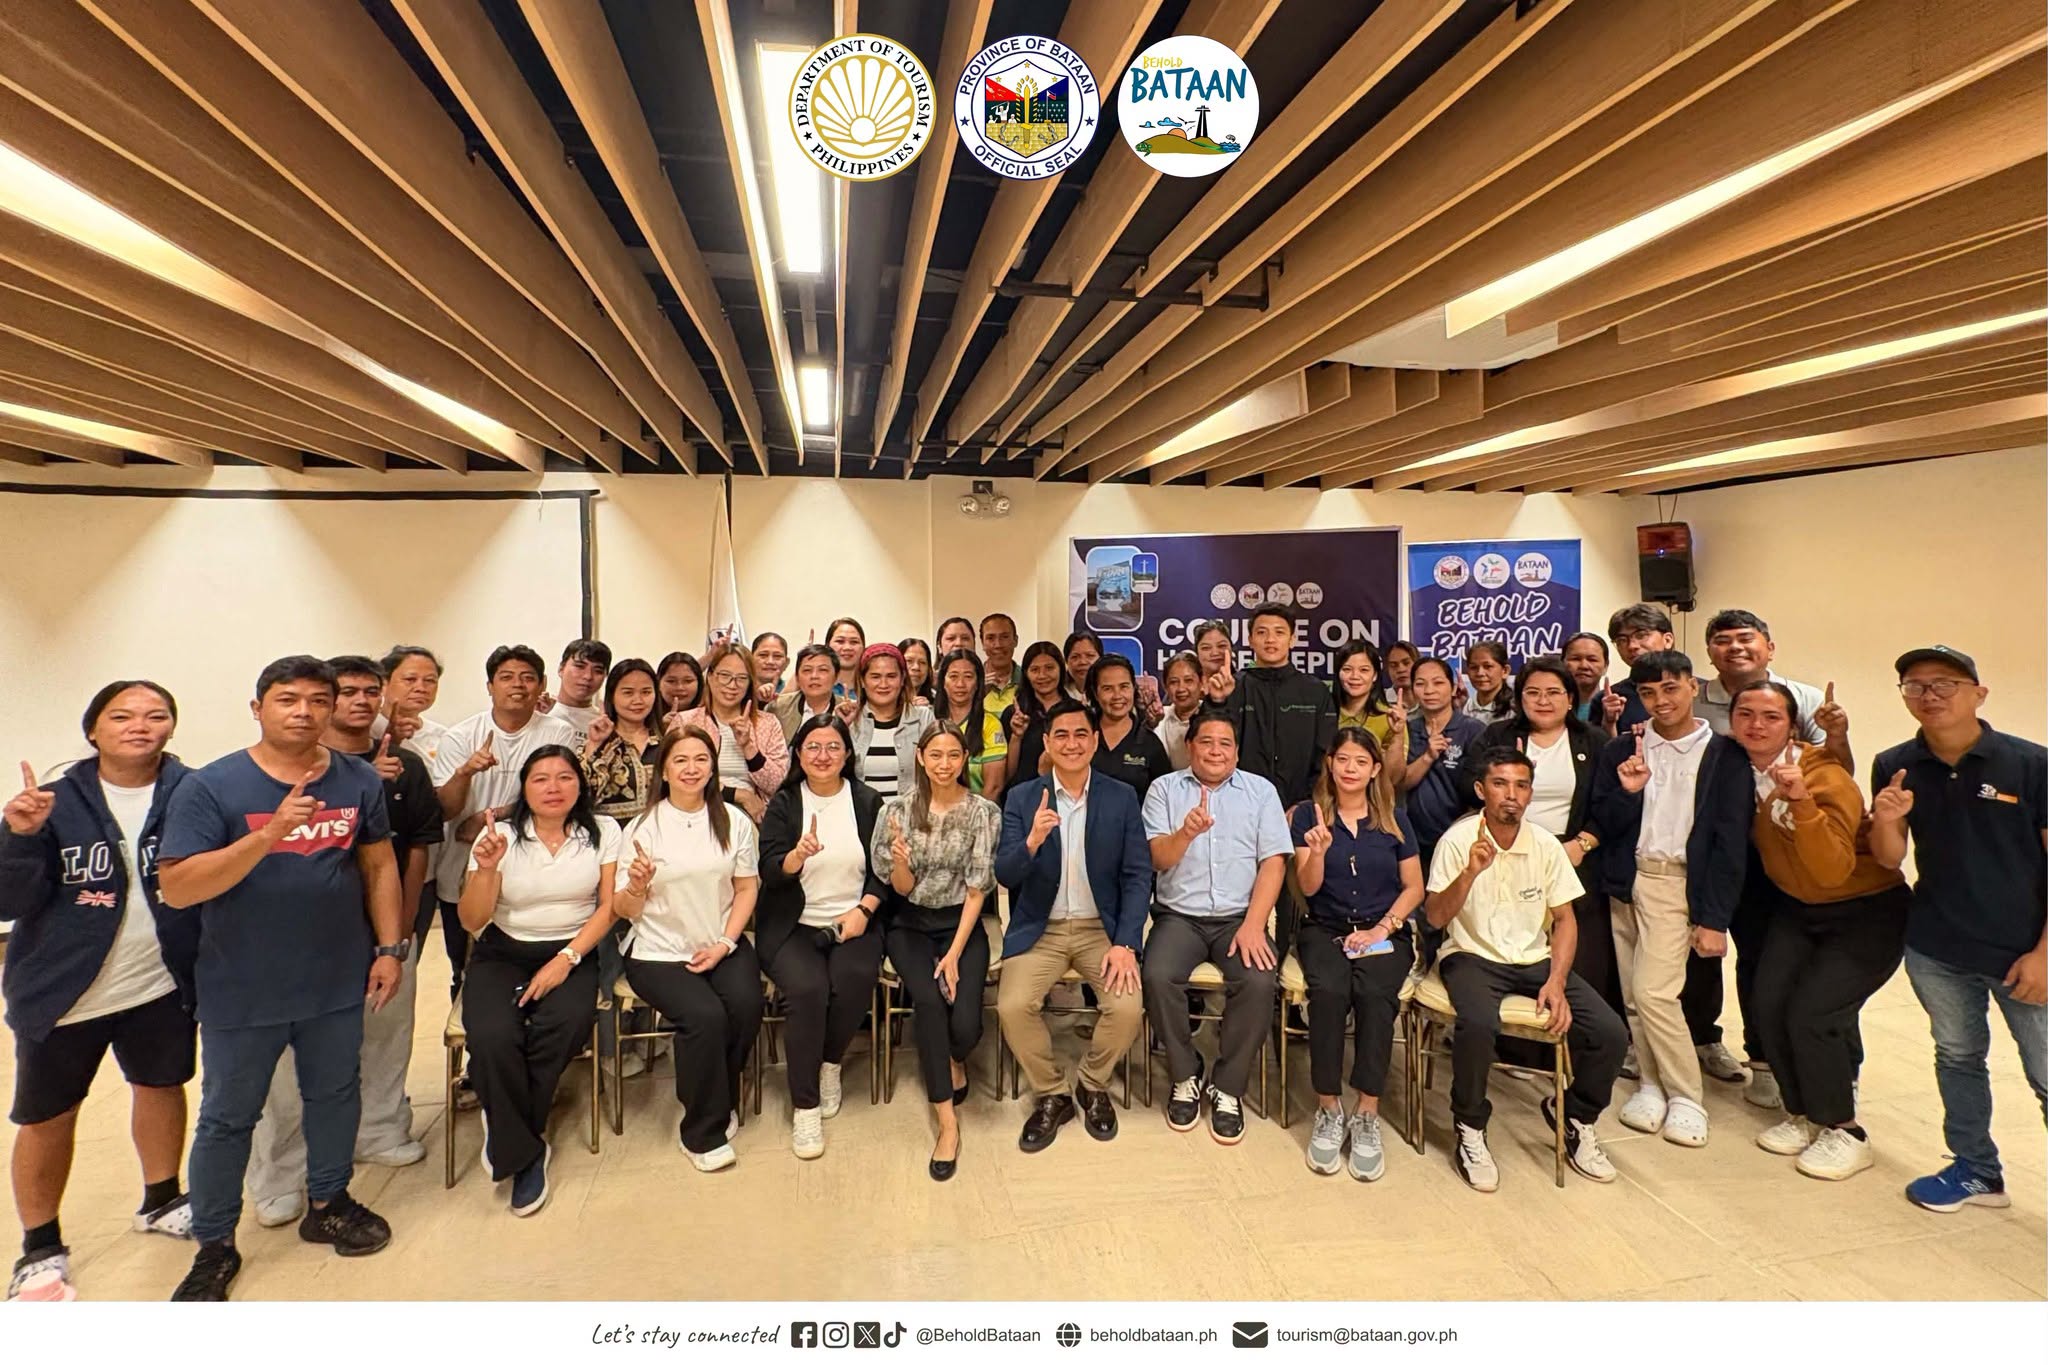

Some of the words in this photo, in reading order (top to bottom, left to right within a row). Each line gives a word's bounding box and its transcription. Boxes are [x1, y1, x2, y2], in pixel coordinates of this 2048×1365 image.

[1517, 560, 1549, 570] BATAAN
[1438, 591, 1551, 628] BEHOLD
[1319, 618, 1380, 649] ON
